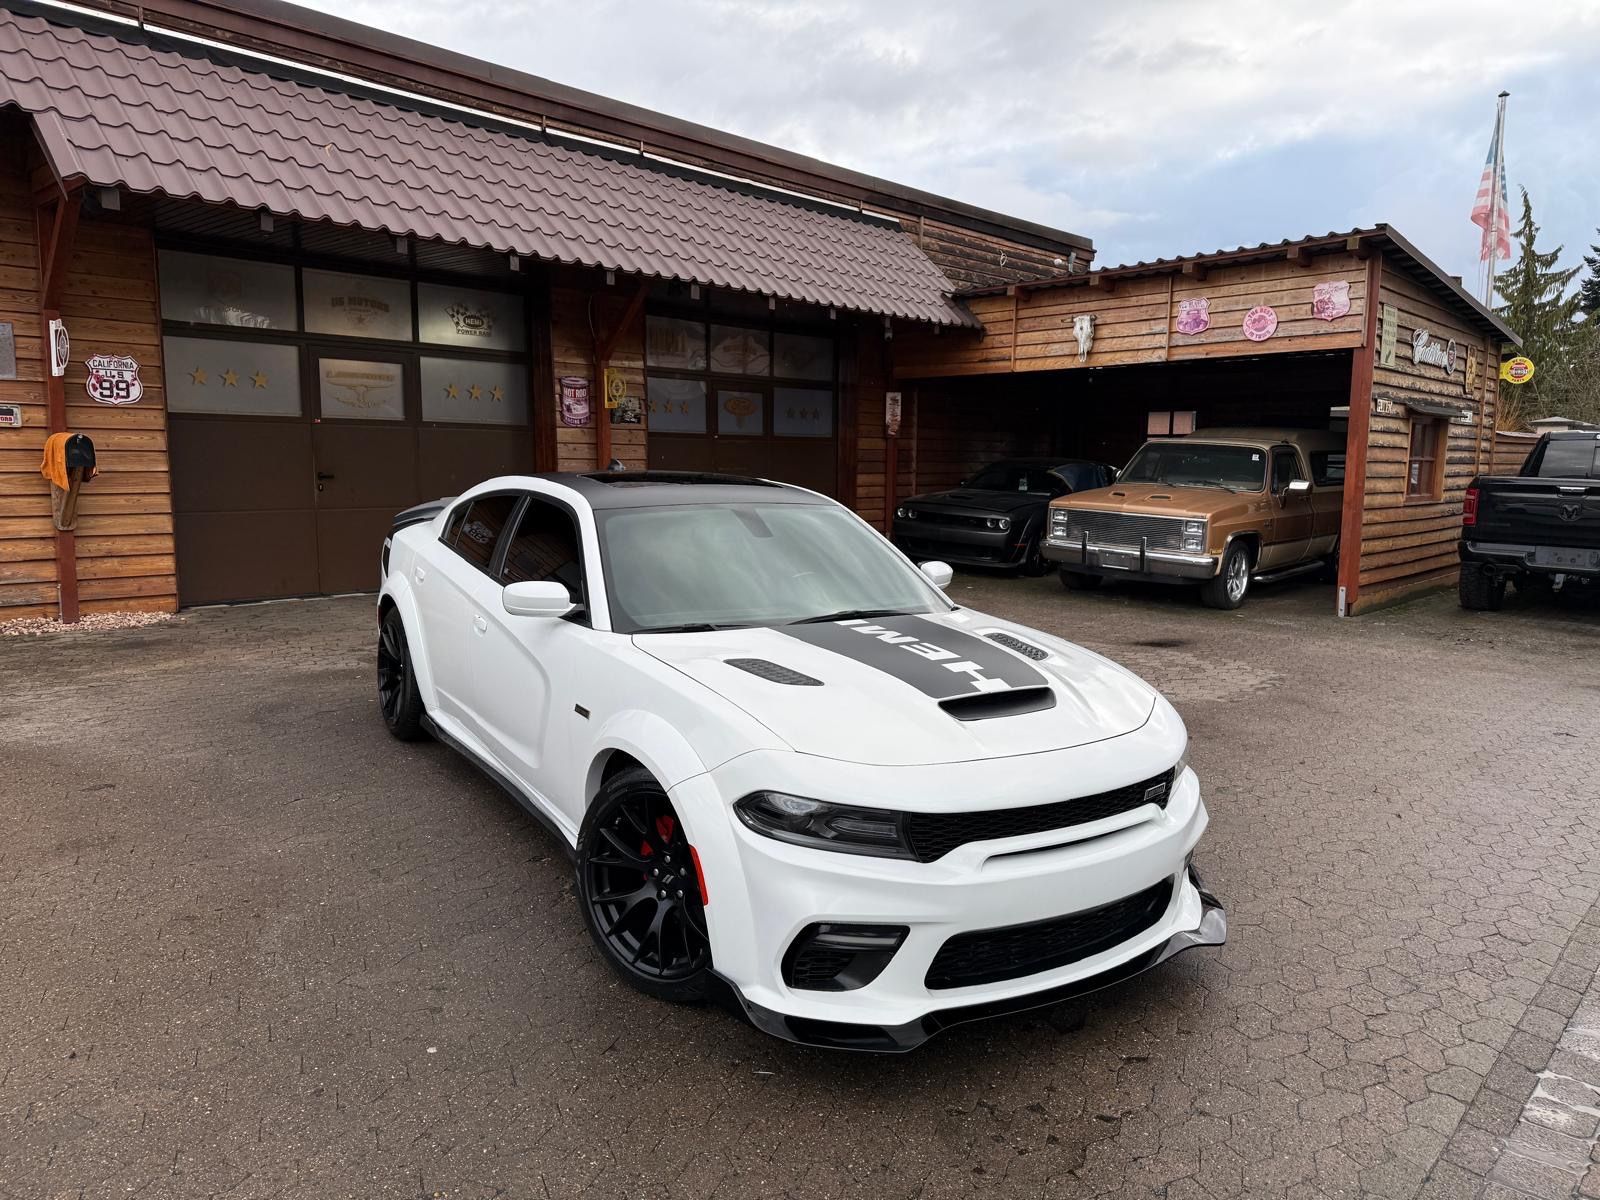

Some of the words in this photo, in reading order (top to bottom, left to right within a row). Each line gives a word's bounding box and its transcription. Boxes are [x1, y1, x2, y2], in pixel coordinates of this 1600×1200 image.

[464, 317, 483, 326] HEMI
[93, 360, 134, 369] CALIFORNIA
[99, 379, 130, 399] 99
[564, 388, 575, 398] HOT
[575, 389, 587, 398] ROD
